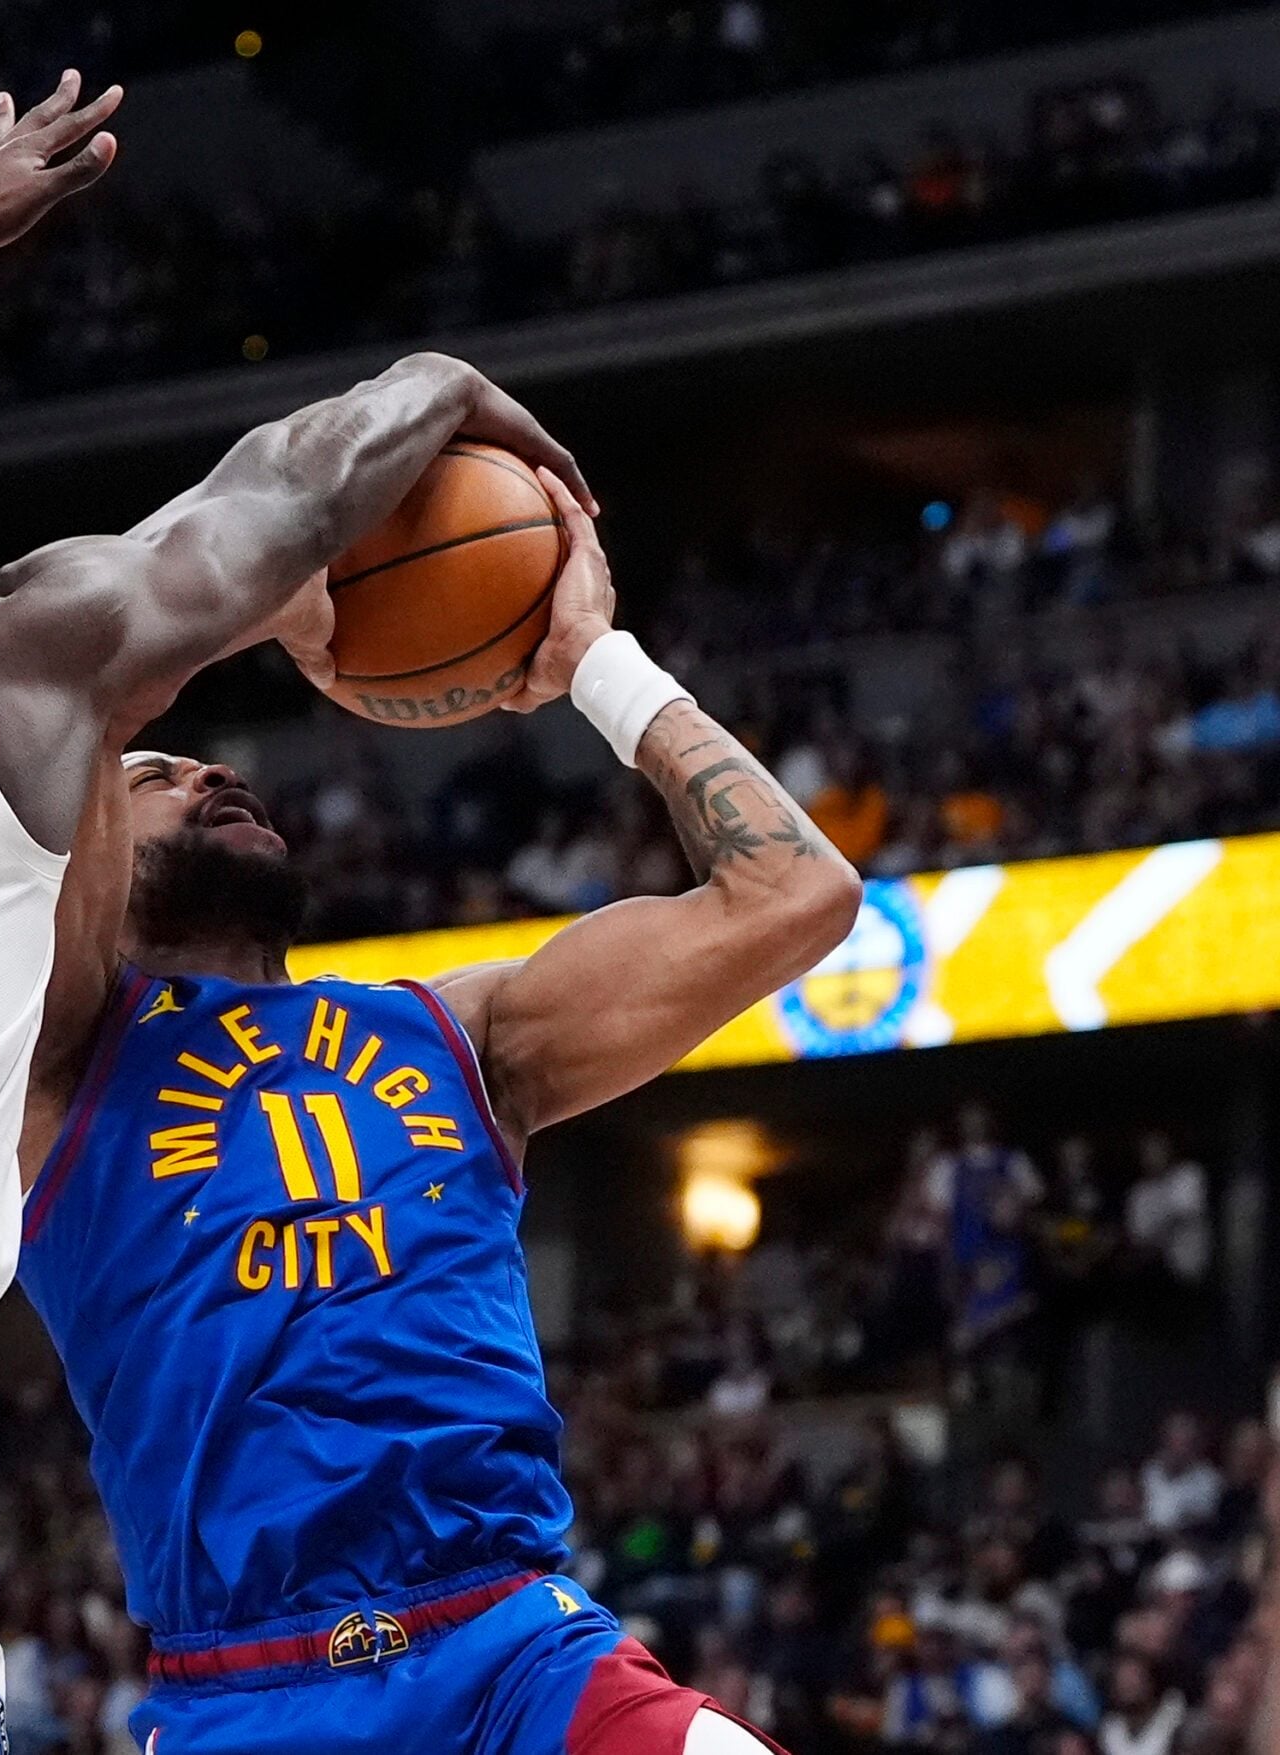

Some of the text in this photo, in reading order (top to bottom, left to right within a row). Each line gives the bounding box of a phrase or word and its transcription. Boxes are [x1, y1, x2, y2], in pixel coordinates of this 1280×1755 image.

[353, 666, 525, 720] Wilso
[148, 997, 464, 1180] MILE HIGH
[259, 1090, 362, 1203] 11
[235, 1205, 393, 1291] CITY
